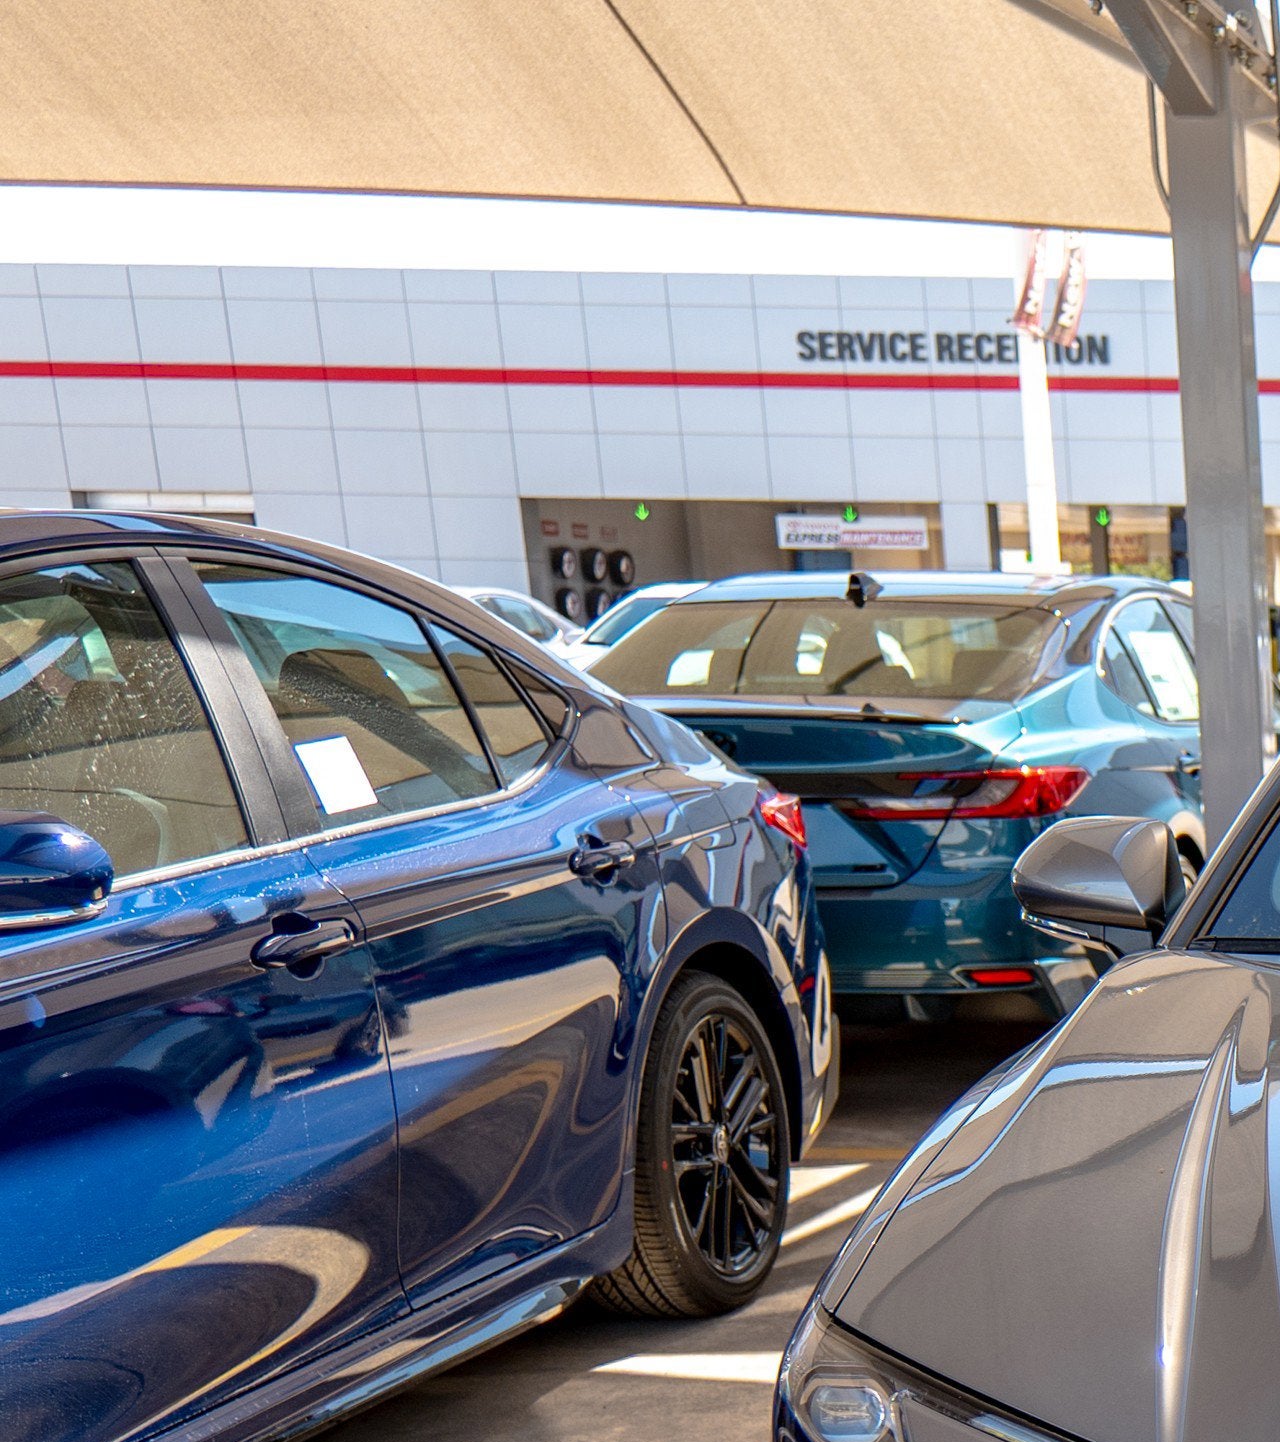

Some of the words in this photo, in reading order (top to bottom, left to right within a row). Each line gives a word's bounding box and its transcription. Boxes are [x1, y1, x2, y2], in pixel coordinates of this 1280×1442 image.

[797, 331, 927, 363] SERVICE
[935, 333, 1110, 365] RECEION
[786, 532, 840, 545] EXPRESS
